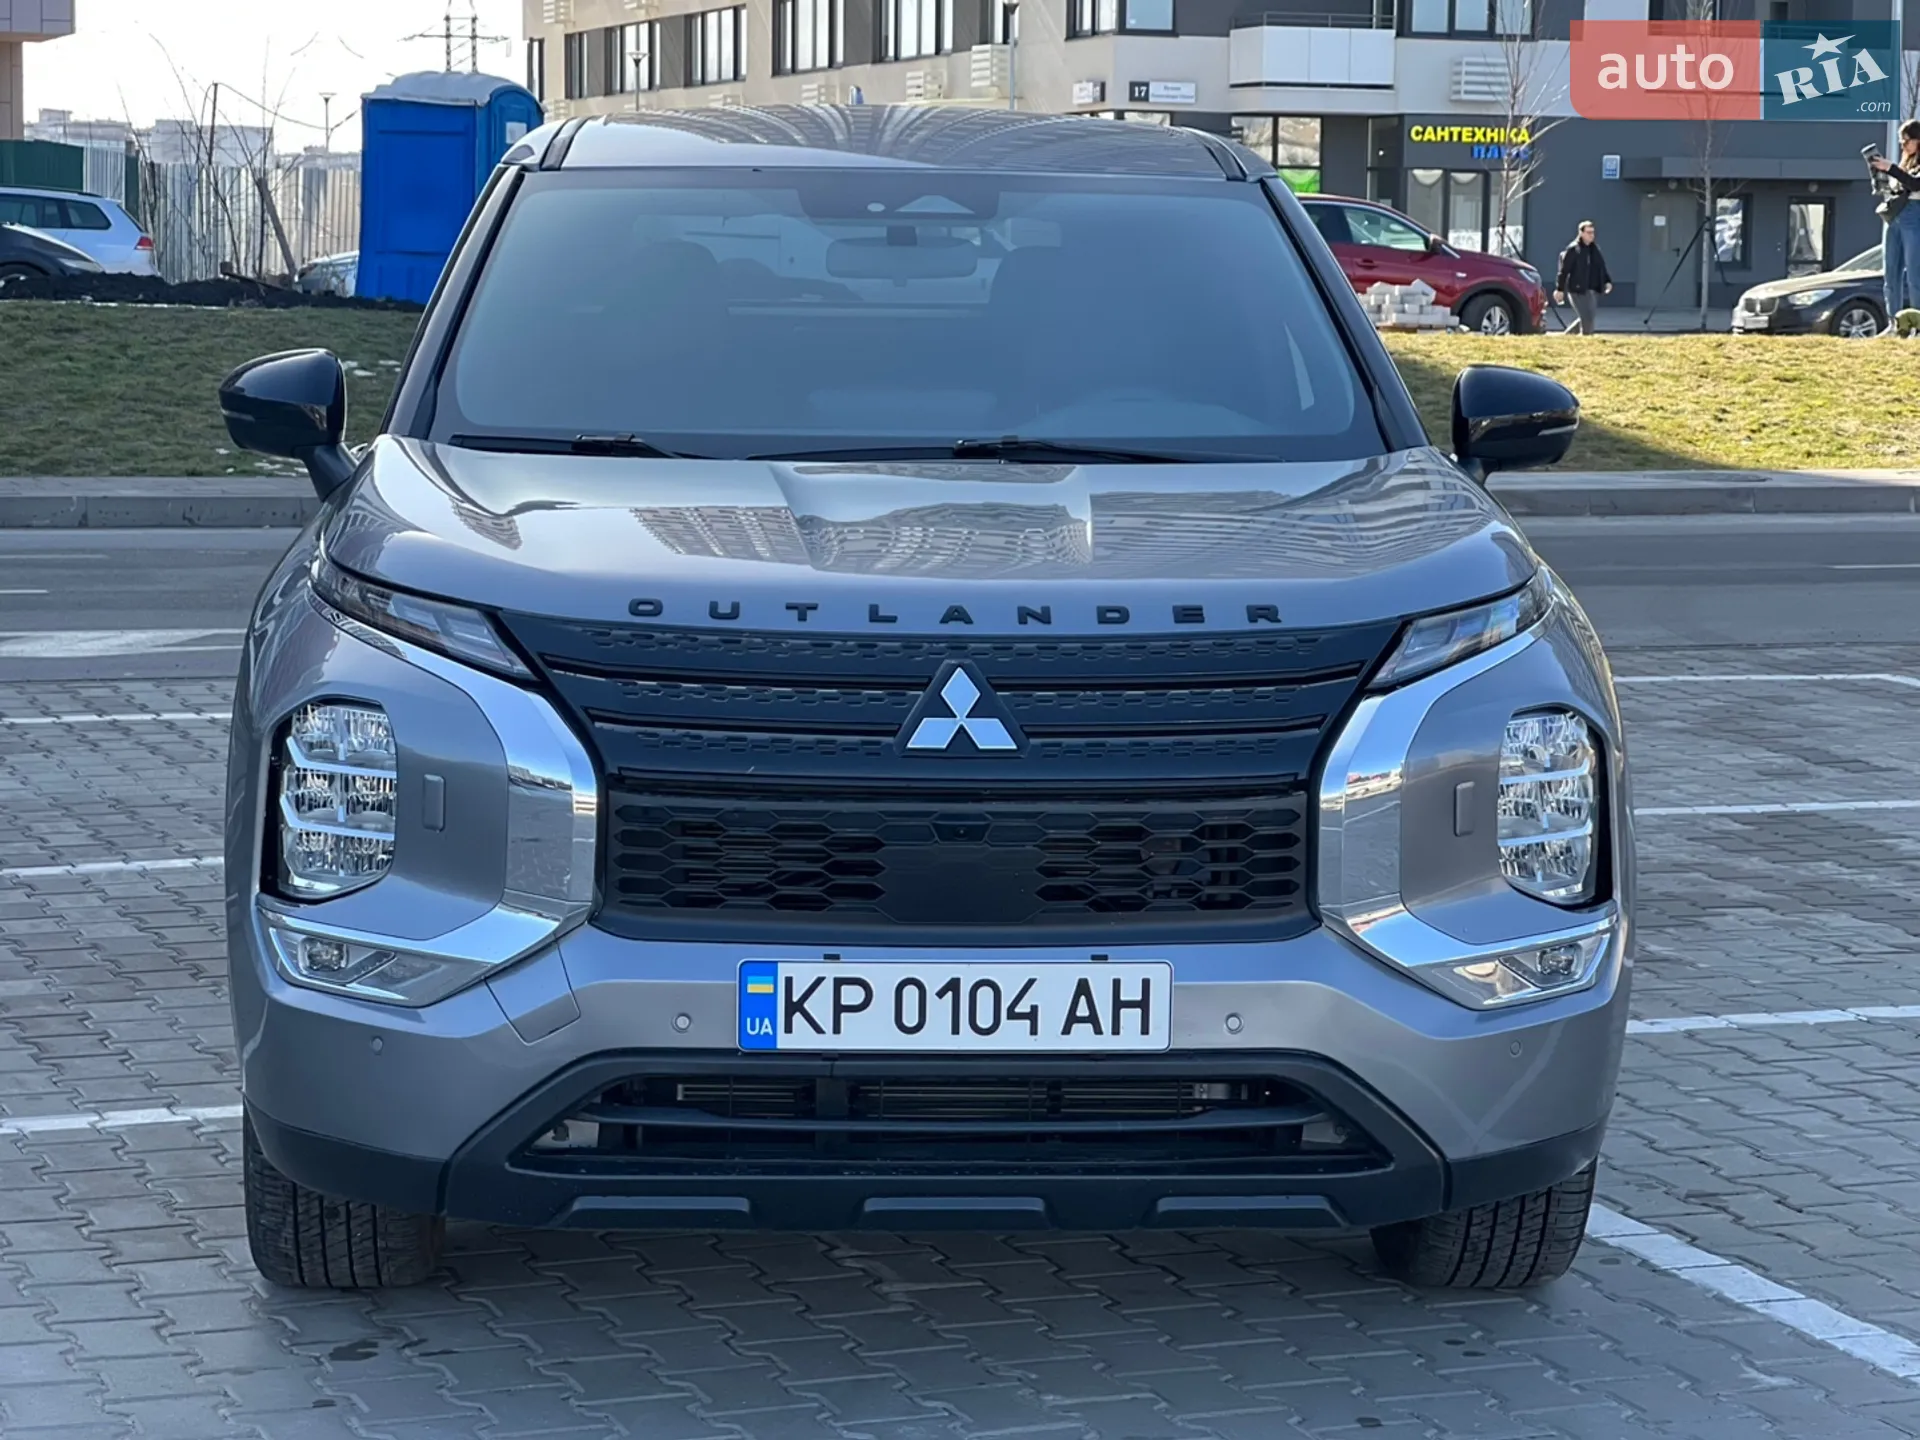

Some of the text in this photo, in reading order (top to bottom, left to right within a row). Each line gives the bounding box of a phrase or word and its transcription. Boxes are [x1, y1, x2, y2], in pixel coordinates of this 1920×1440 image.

[1134, 85, 1148, 98] 17
[1410, 125, 1530, 144] САНТЕХНІКА
[627, 598, 1283, 626] OUTLANDER
[782, 976, 1151, 1037] KP 0104 AH
[746, 1017, 774, 1037] UA
